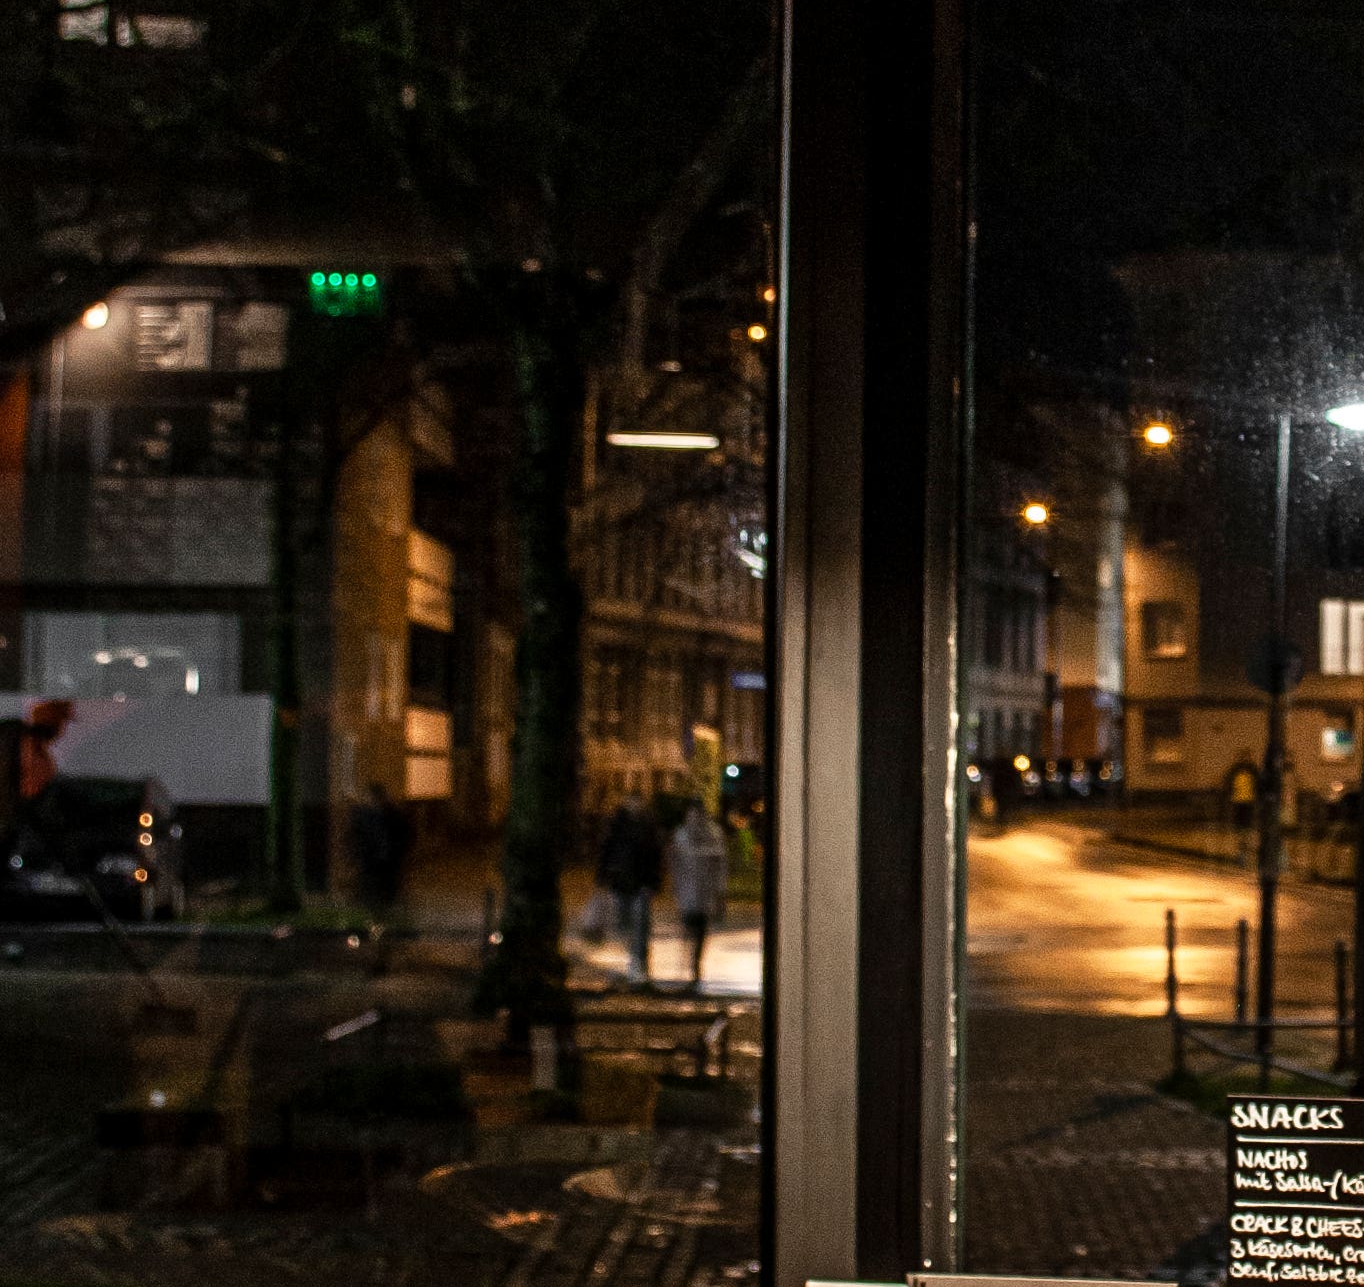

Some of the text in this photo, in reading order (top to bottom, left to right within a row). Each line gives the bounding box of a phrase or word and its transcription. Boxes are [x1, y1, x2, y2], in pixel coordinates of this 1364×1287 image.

[1231, 1103, 1343, 1130] SNACKS
[1237, 1148, 1307, 1170] NACHOS
[1235, 1172, 1272, 1189] mit
[1231, 1213, 1289, 1233] CRACK
